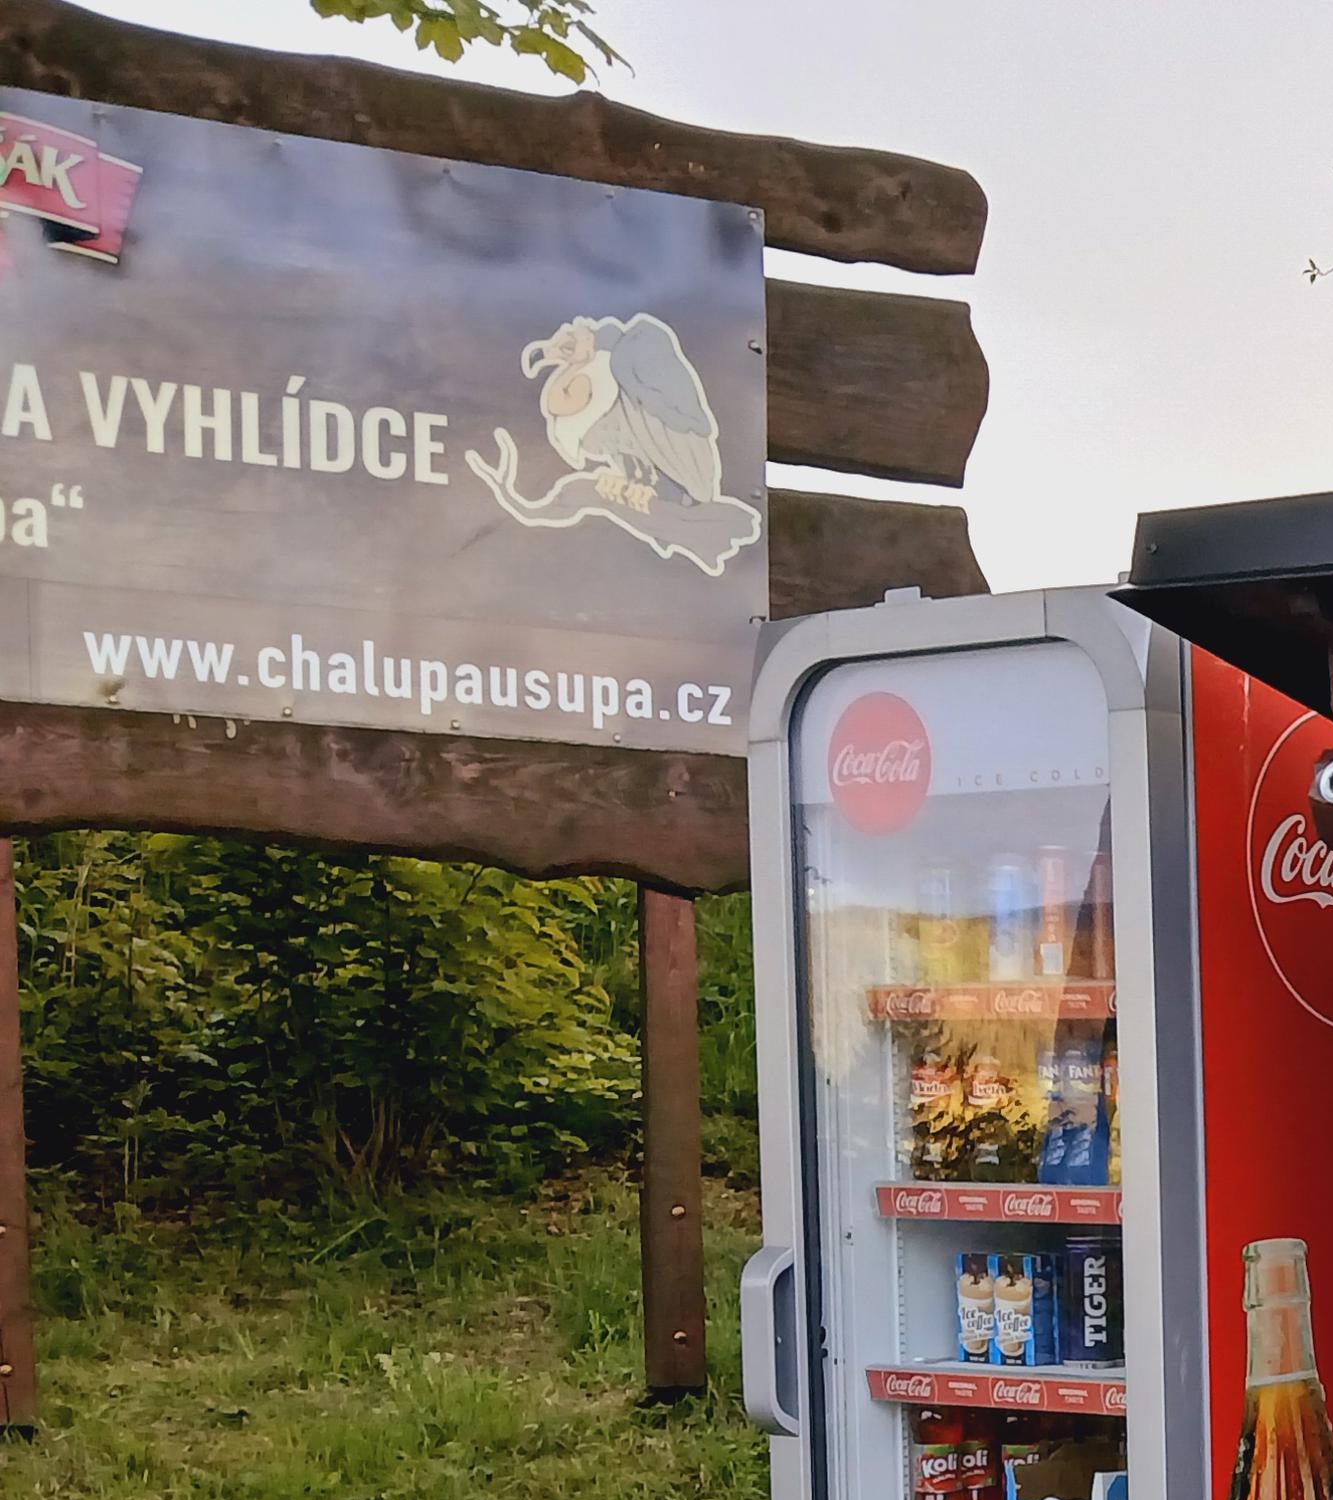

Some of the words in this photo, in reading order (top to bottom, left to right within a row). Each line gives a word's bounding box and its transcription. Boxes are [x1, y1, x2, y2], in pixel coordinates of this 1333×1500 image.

[79, 370, 450, 486] VYHLÍDCE
[84, 630, 733, 728] www.chalupausupa.cz
[832, 740, 924, 787] Coca-Cola
[1029, 765, 1105, 783] COLD
[1084, 1256, 1107, 1348] TIGER
[962, 1449, 988, 1468] oli
